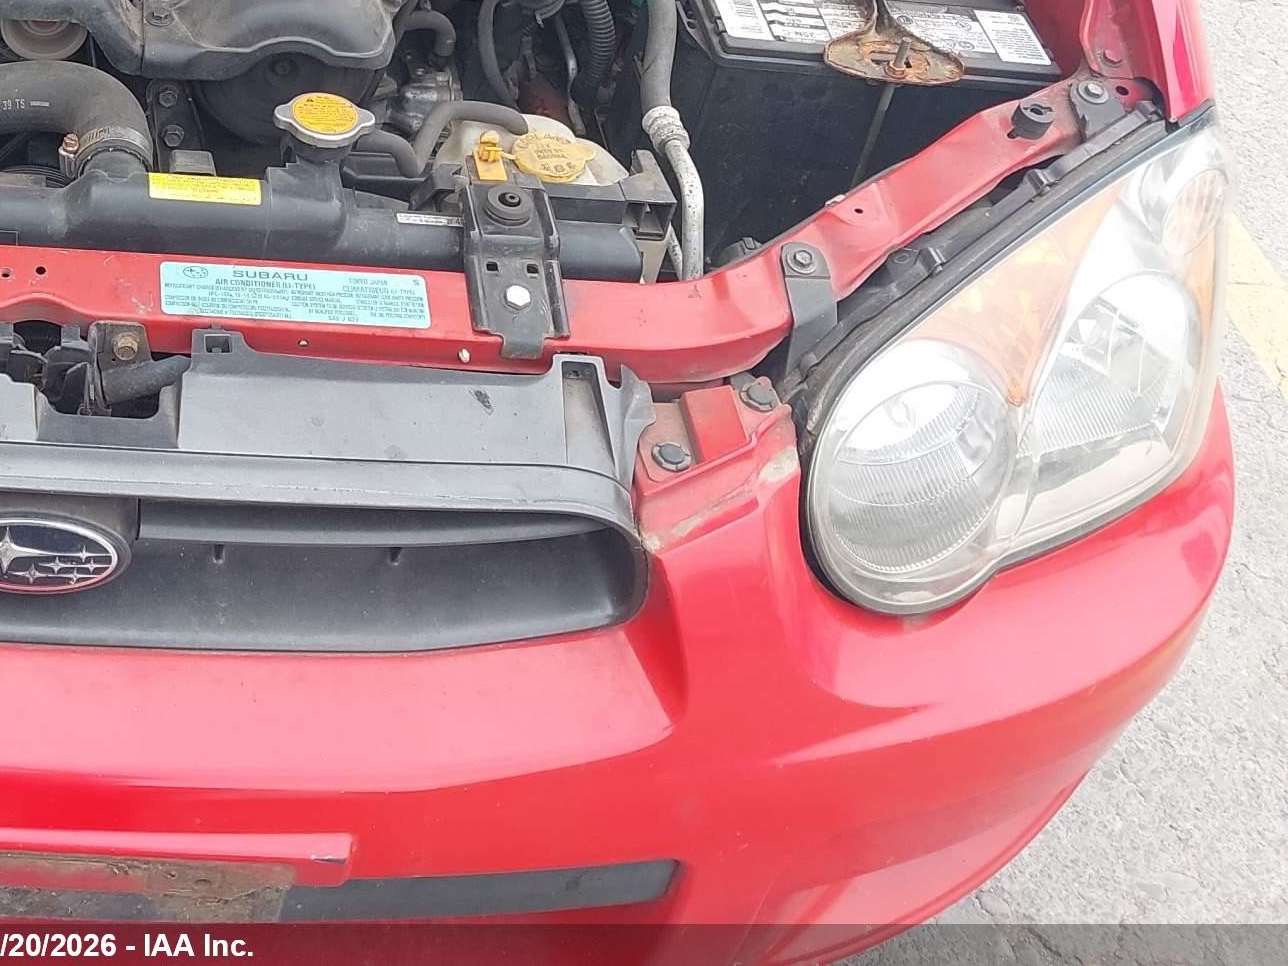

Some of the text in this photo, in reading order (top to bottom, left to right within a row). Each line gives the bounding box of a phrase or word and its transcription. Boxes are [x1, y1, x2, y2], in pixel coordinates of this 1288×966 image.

[2, 99, 12, 111] 39
[15, 98, 25, 110] TS
[233, 270, 309, 282] SUBARU
[215, 278, 229, 286] AIR
[230, 279, 281, 289] CONDITIONER
